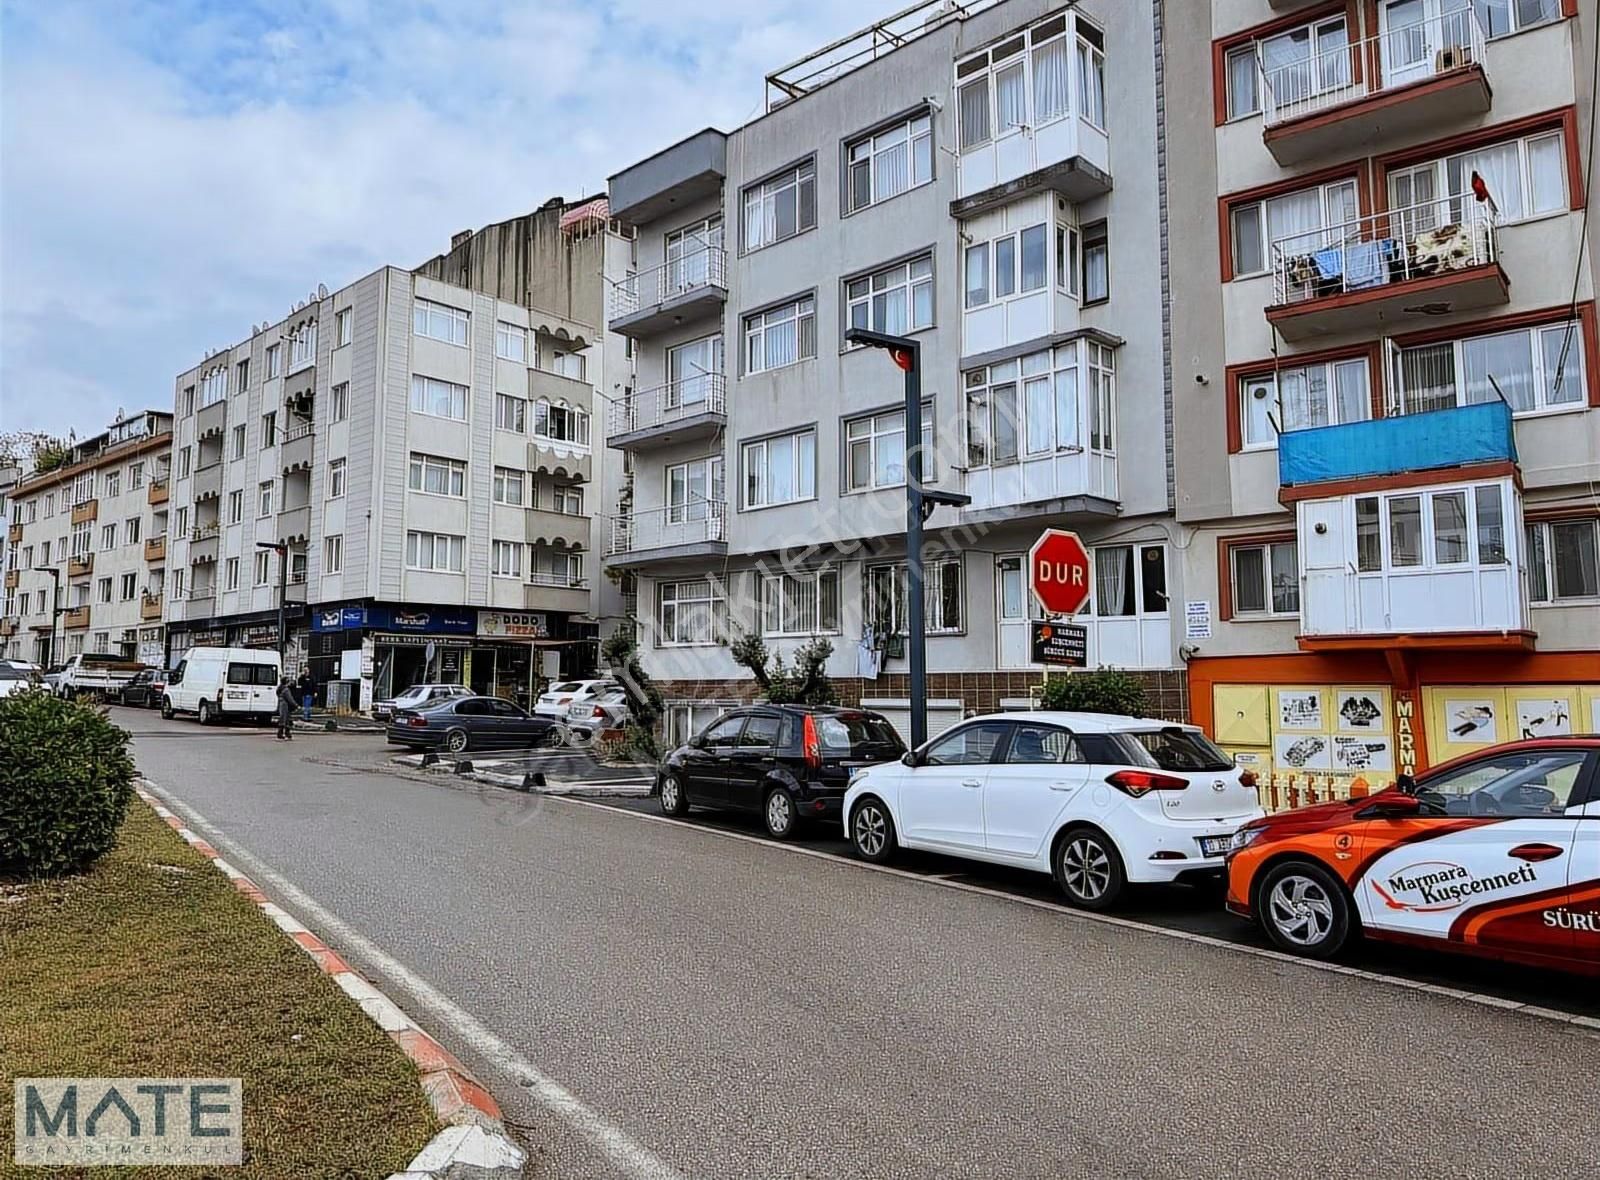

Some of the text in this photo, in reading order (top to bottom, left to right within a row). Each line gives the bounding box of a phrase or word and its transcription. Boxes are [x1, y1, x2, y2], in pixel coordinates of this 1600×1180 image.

[1039, 560, 1083, 586] DUR
[503, 615, 539, 625] DODO
[1338, 835, 1349, 848] 4
[1388, 865, 1468, 894] Marmara
[1420, 863, 1537, 904] Kuşcenneti
